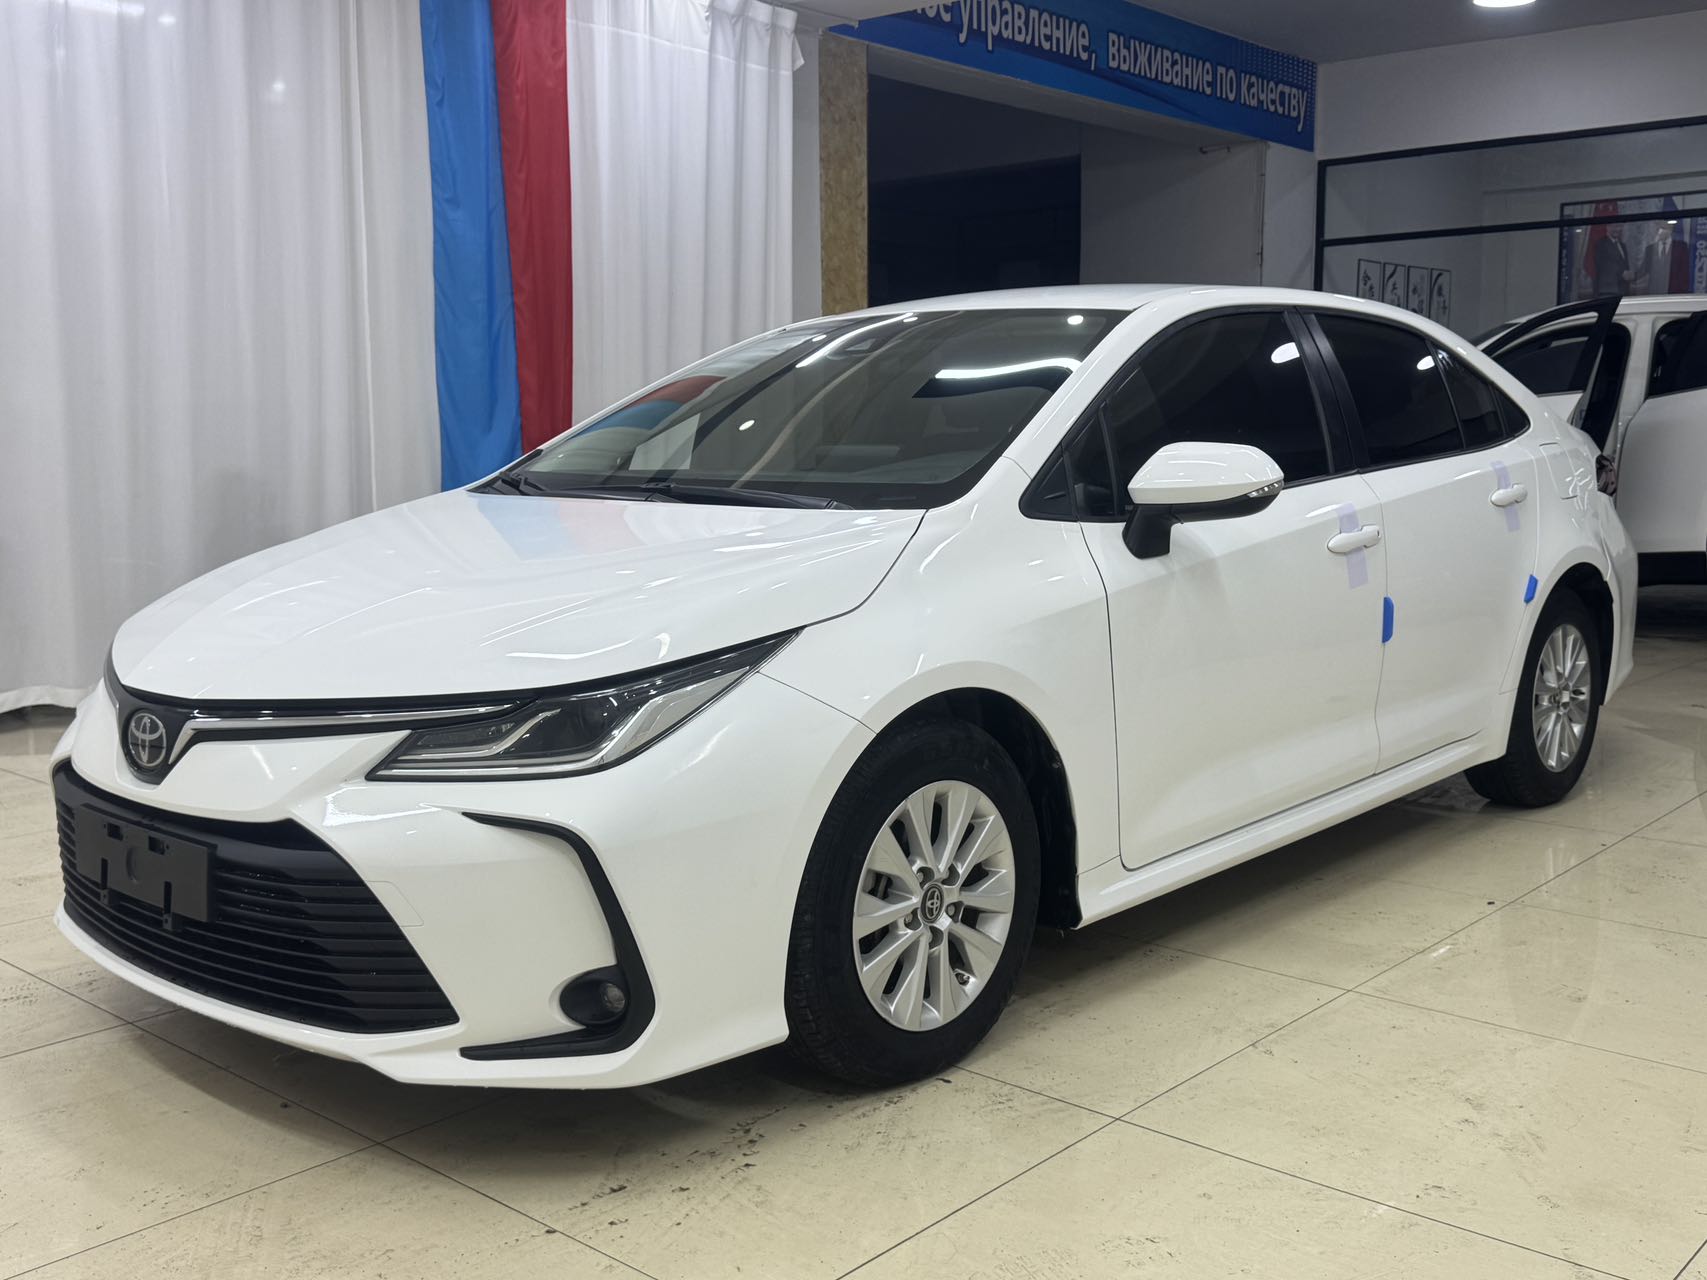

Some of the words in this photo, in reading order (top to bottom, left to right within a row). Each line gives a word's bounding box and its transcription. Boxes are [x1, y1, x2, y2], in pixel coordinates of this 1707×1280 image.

[956, 0, 1096, 71] управление,
[1108, 32, 1213, 96] выживание
[1216, 65, 1237, 102] по
[1240, 72, 1308, 132] качеству
